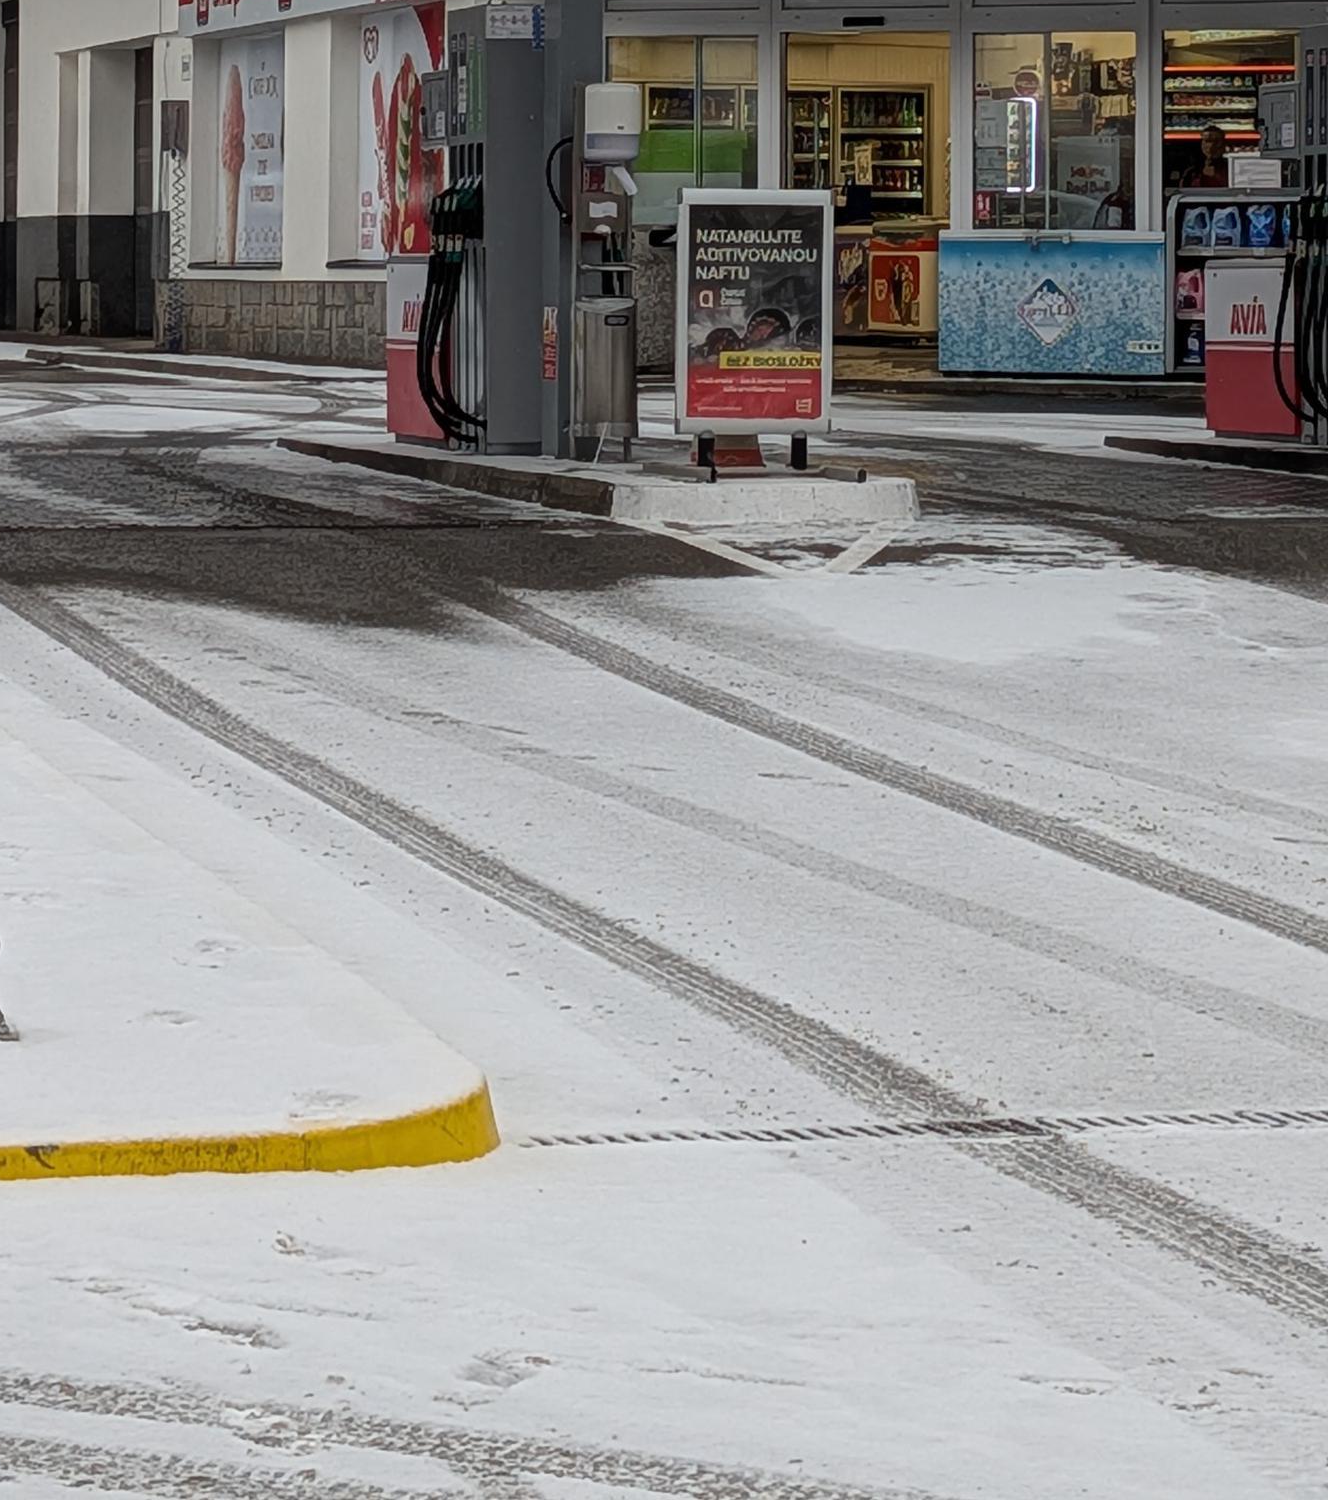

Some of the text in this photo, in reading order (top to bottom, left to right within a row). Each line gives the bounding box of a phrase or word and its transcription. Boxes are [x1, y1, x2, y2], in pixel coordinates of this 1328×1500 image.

[695, 228, 803, 244] NATANKUJTE
[695, 247, 818, 263] ADITIVOVANOU
[695, 265, 750, 281] NAFTU
